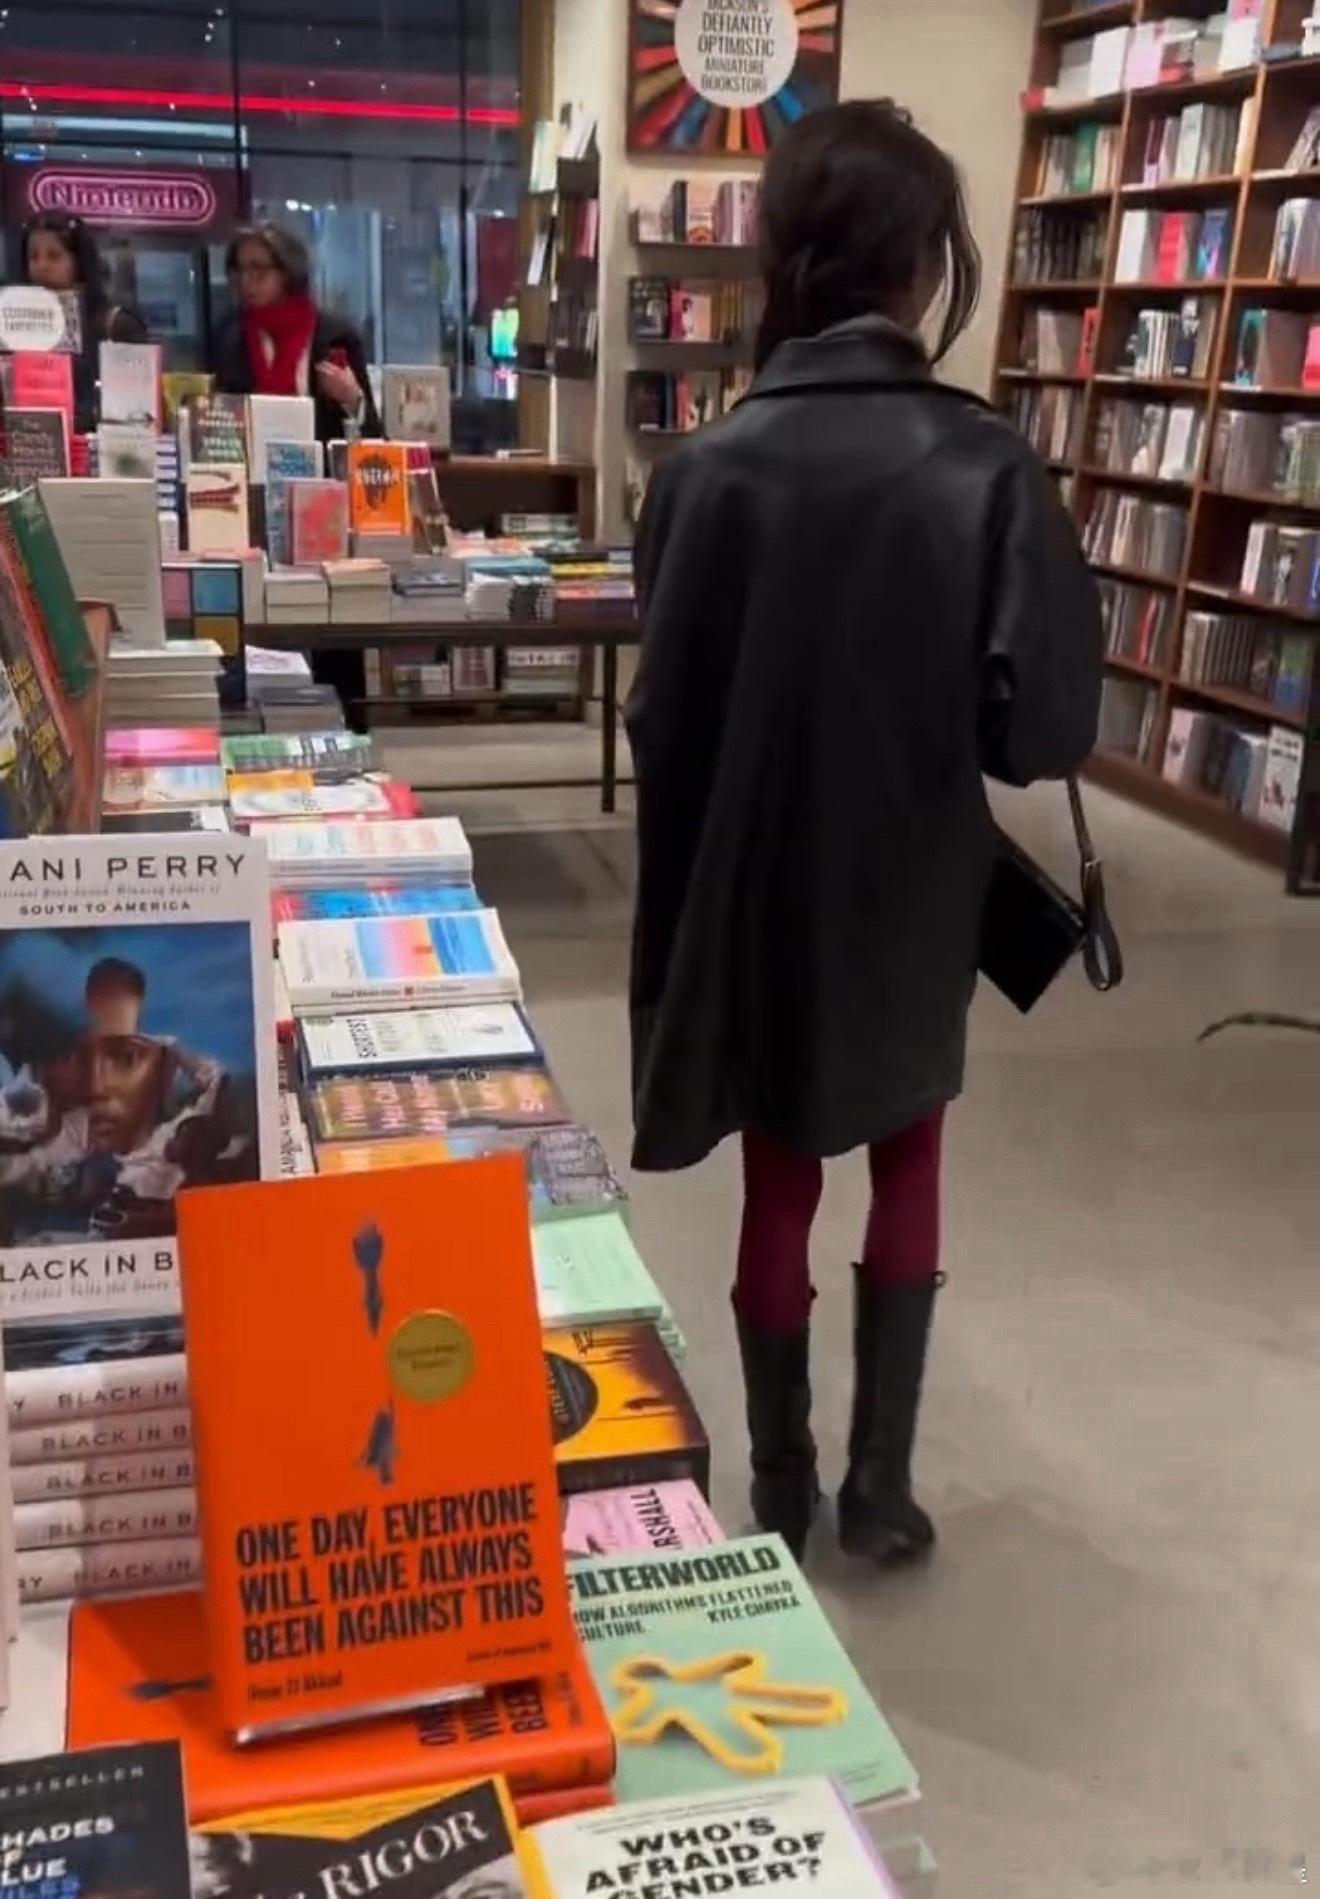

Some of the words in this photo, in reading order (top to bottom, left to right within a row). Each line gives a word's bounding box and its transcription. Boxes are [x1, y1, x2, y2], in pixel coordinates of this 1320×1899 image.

[702, 12, 773, 34] DEFIANTLY
[698, 33, 775, 57] OPTIMISTIC
[50, 182, 200, 210] Nintendo
[10, 858, 82, 881] ANI
[107, 853, 245, 880] PERRY
[19, 902, 79, 916] SOUTH
[87, 902, 107, 915] TO
[113, 899, 191, 914] AMERICA
[105, 1254, 136, 1277] IN
[58, 1386, 141, 1408] BLACK
[154, 1382, 178, 1397] IN
[42, 1430, 125, 1449] BLACK
[138, 1425, 161, 1441] IN
[47, 1470, 130, 1488] BLACK
[142, 1465, 165, 1480] IN
[49, 1518, 130, 1537] BLACK
[142, 1514, 166, 1530] IN
[235, 1521, 301, 1567] ONE
[311, 1509, 378, 1559] DAY,
[384, 1483, 538, 1544] EVERYONE
[631, 1488, 682, 1550] RSHALL
[74, 1564, 152, 1584] BLACK
[239, 1566, 318, 1617] WILL
[329, 1551, 409, 1600] HAVE
[419, 1531, 532, 1584] ALWAYS
[610, 1592, 708, 1620] ALGORITHMS
[709, 1579, 794, 1608] FLATTENED
[707, 1605, 744, 1624] KYLE
[745, 1597, 802, 1618] CHAYKA
[243, 1612, 325, 1665] BEEN
[337, 1587, 465, 1649] AGAINST
[475, 1576, 544, 1623] THIS
[2, 1815, 115, 1850] HADES
[620, 1816, 776, 1857] WHO'S
[318, 1810, 488, 1899] RIGOR
[586, 1843, 760, 1894] AFRAID
[772, 1830, 826, 1856] OF
[2, 1856, 67, 1887] LUE
